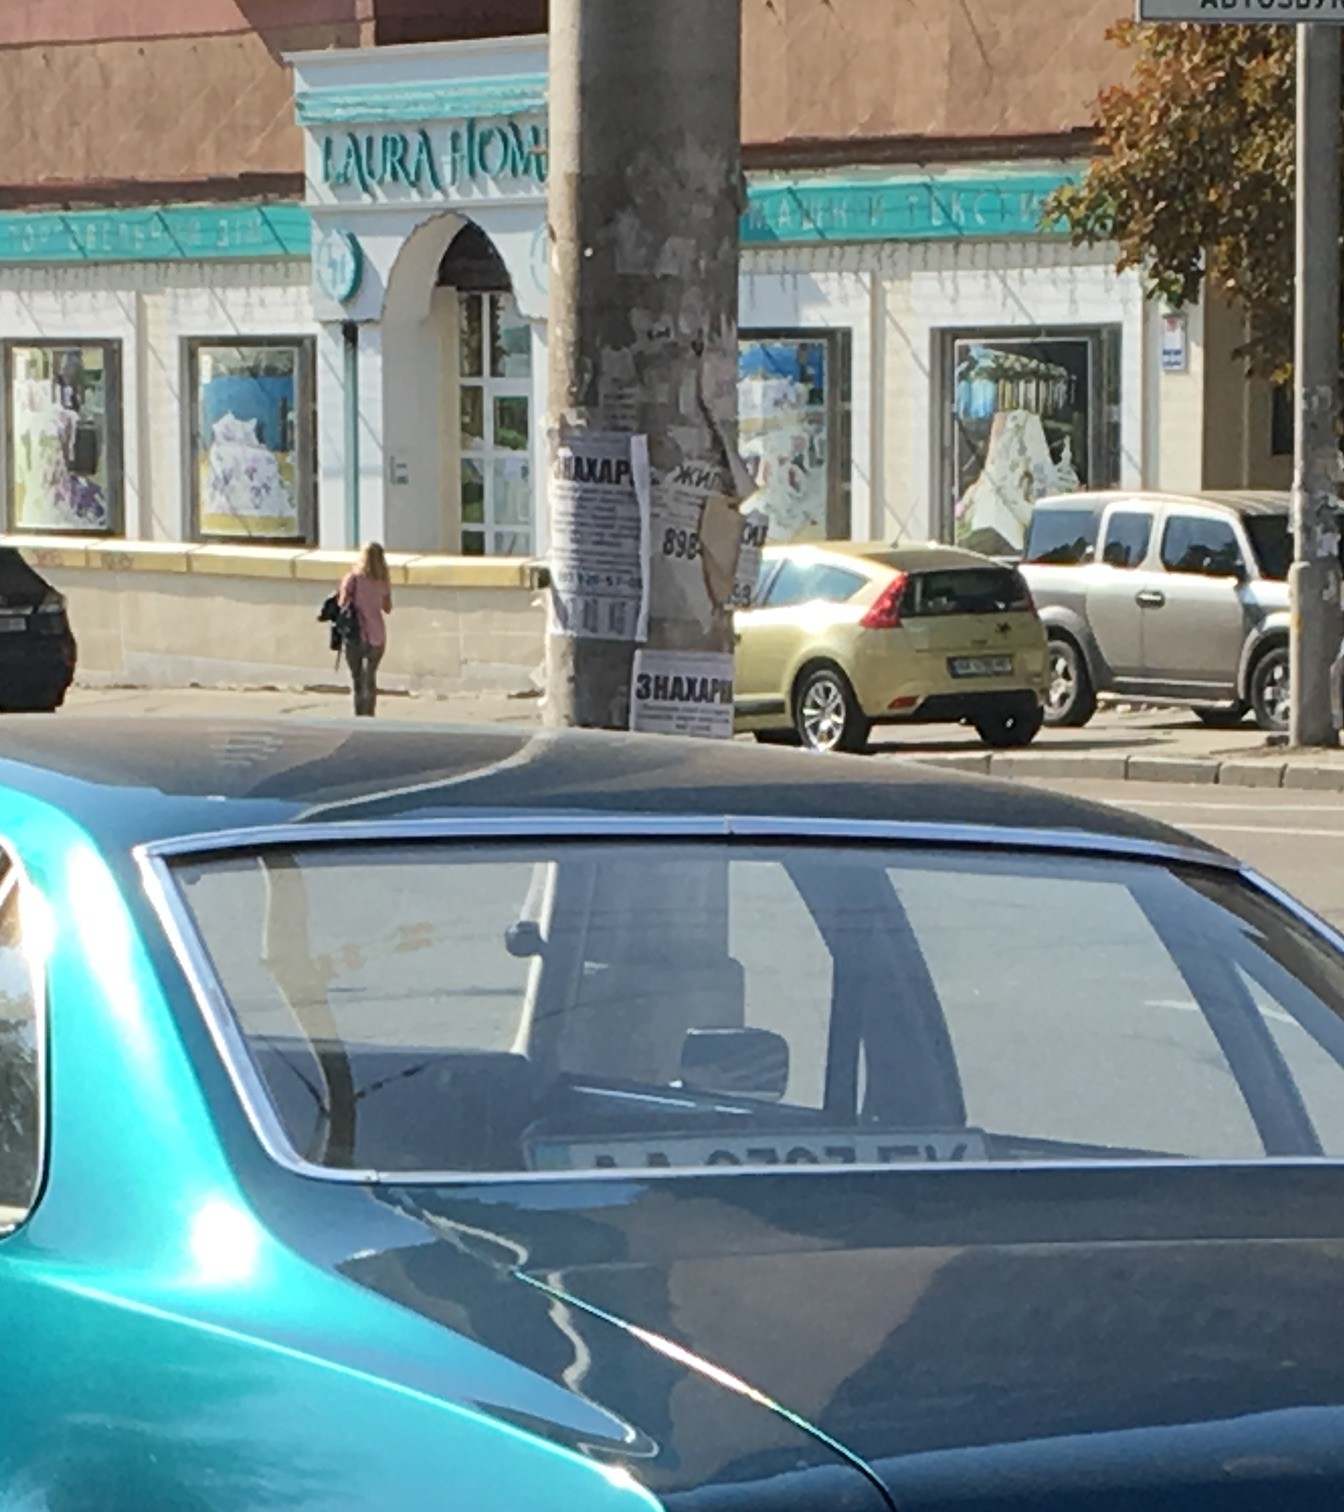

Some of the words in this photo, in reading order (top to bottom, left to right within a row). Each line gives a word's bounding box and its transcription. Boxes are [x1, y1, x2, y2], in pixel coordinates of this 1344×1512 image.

[321, 128, 442, 193] LAURA
[447, 117, 548, 187] HOM
[554, 456, 635, 486] НАХАР
[662, 527, 701, 561] 898
